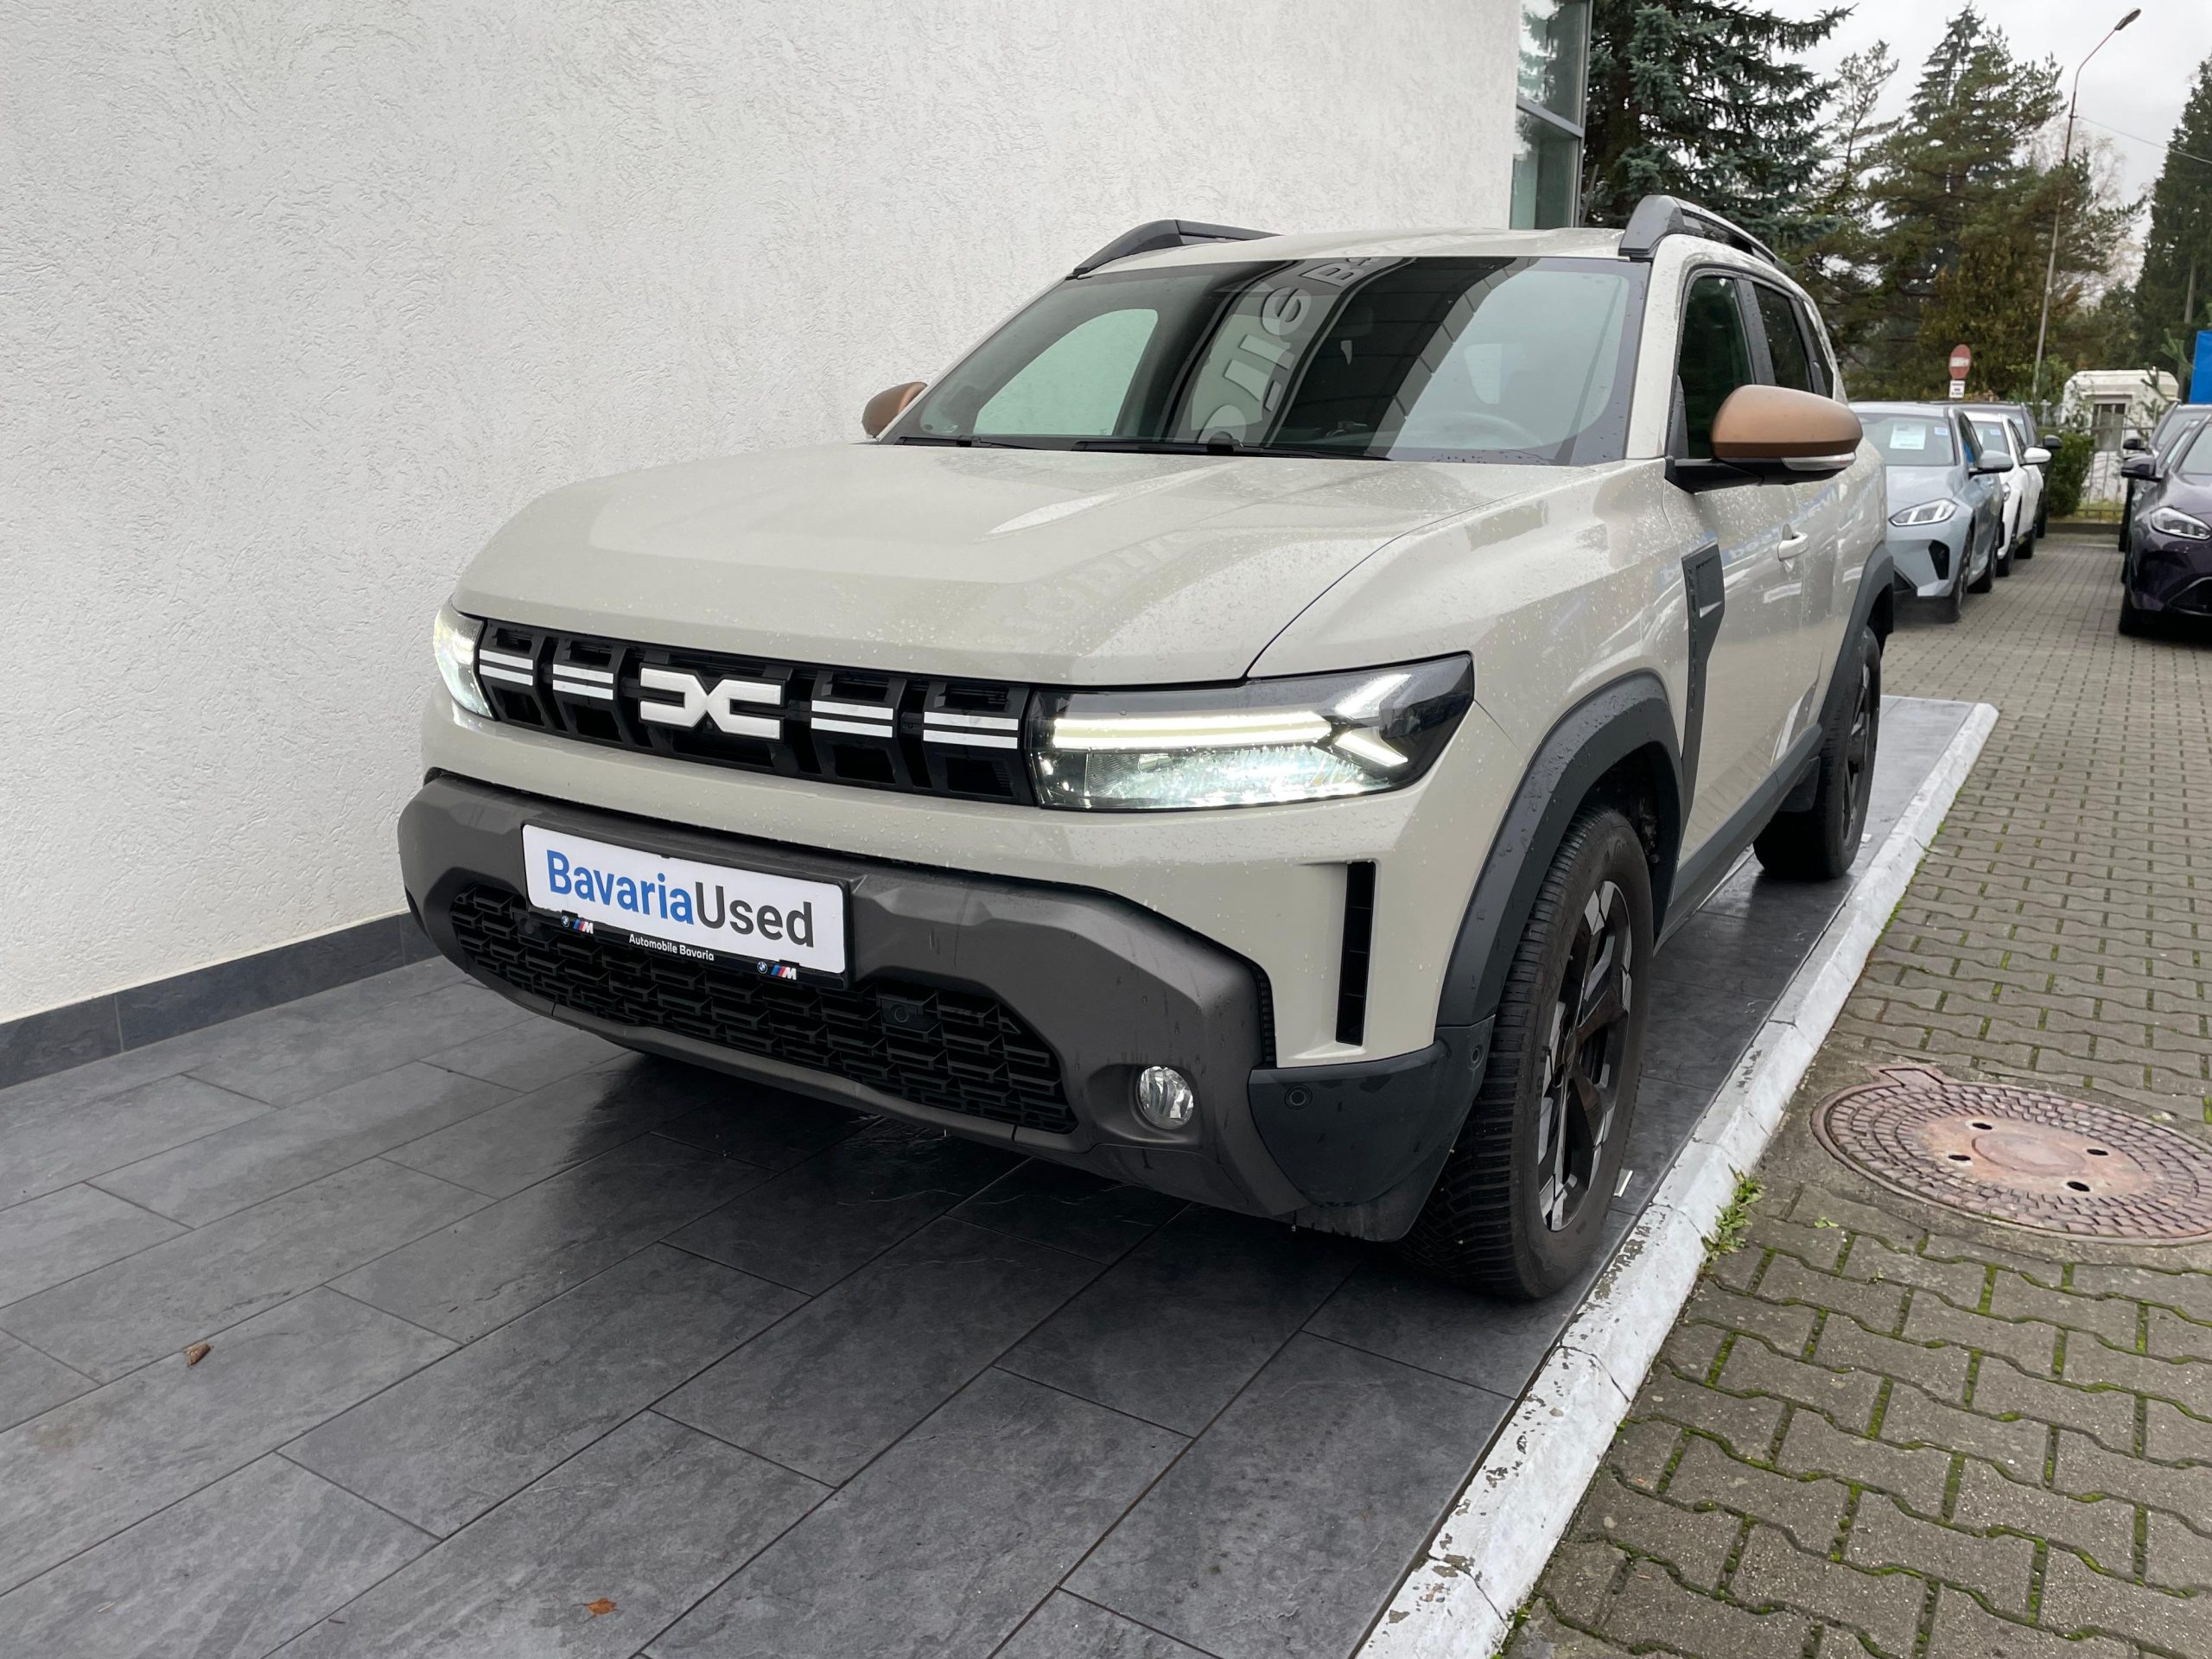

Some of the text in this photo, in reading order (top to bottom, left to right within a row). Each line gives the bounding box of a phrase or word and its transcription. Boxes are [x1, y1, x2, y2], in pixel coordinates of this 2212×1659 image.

[547, 849, 814, 948] BavariaUsed
[629, 933, 715, 962] Automobile Bavaria
